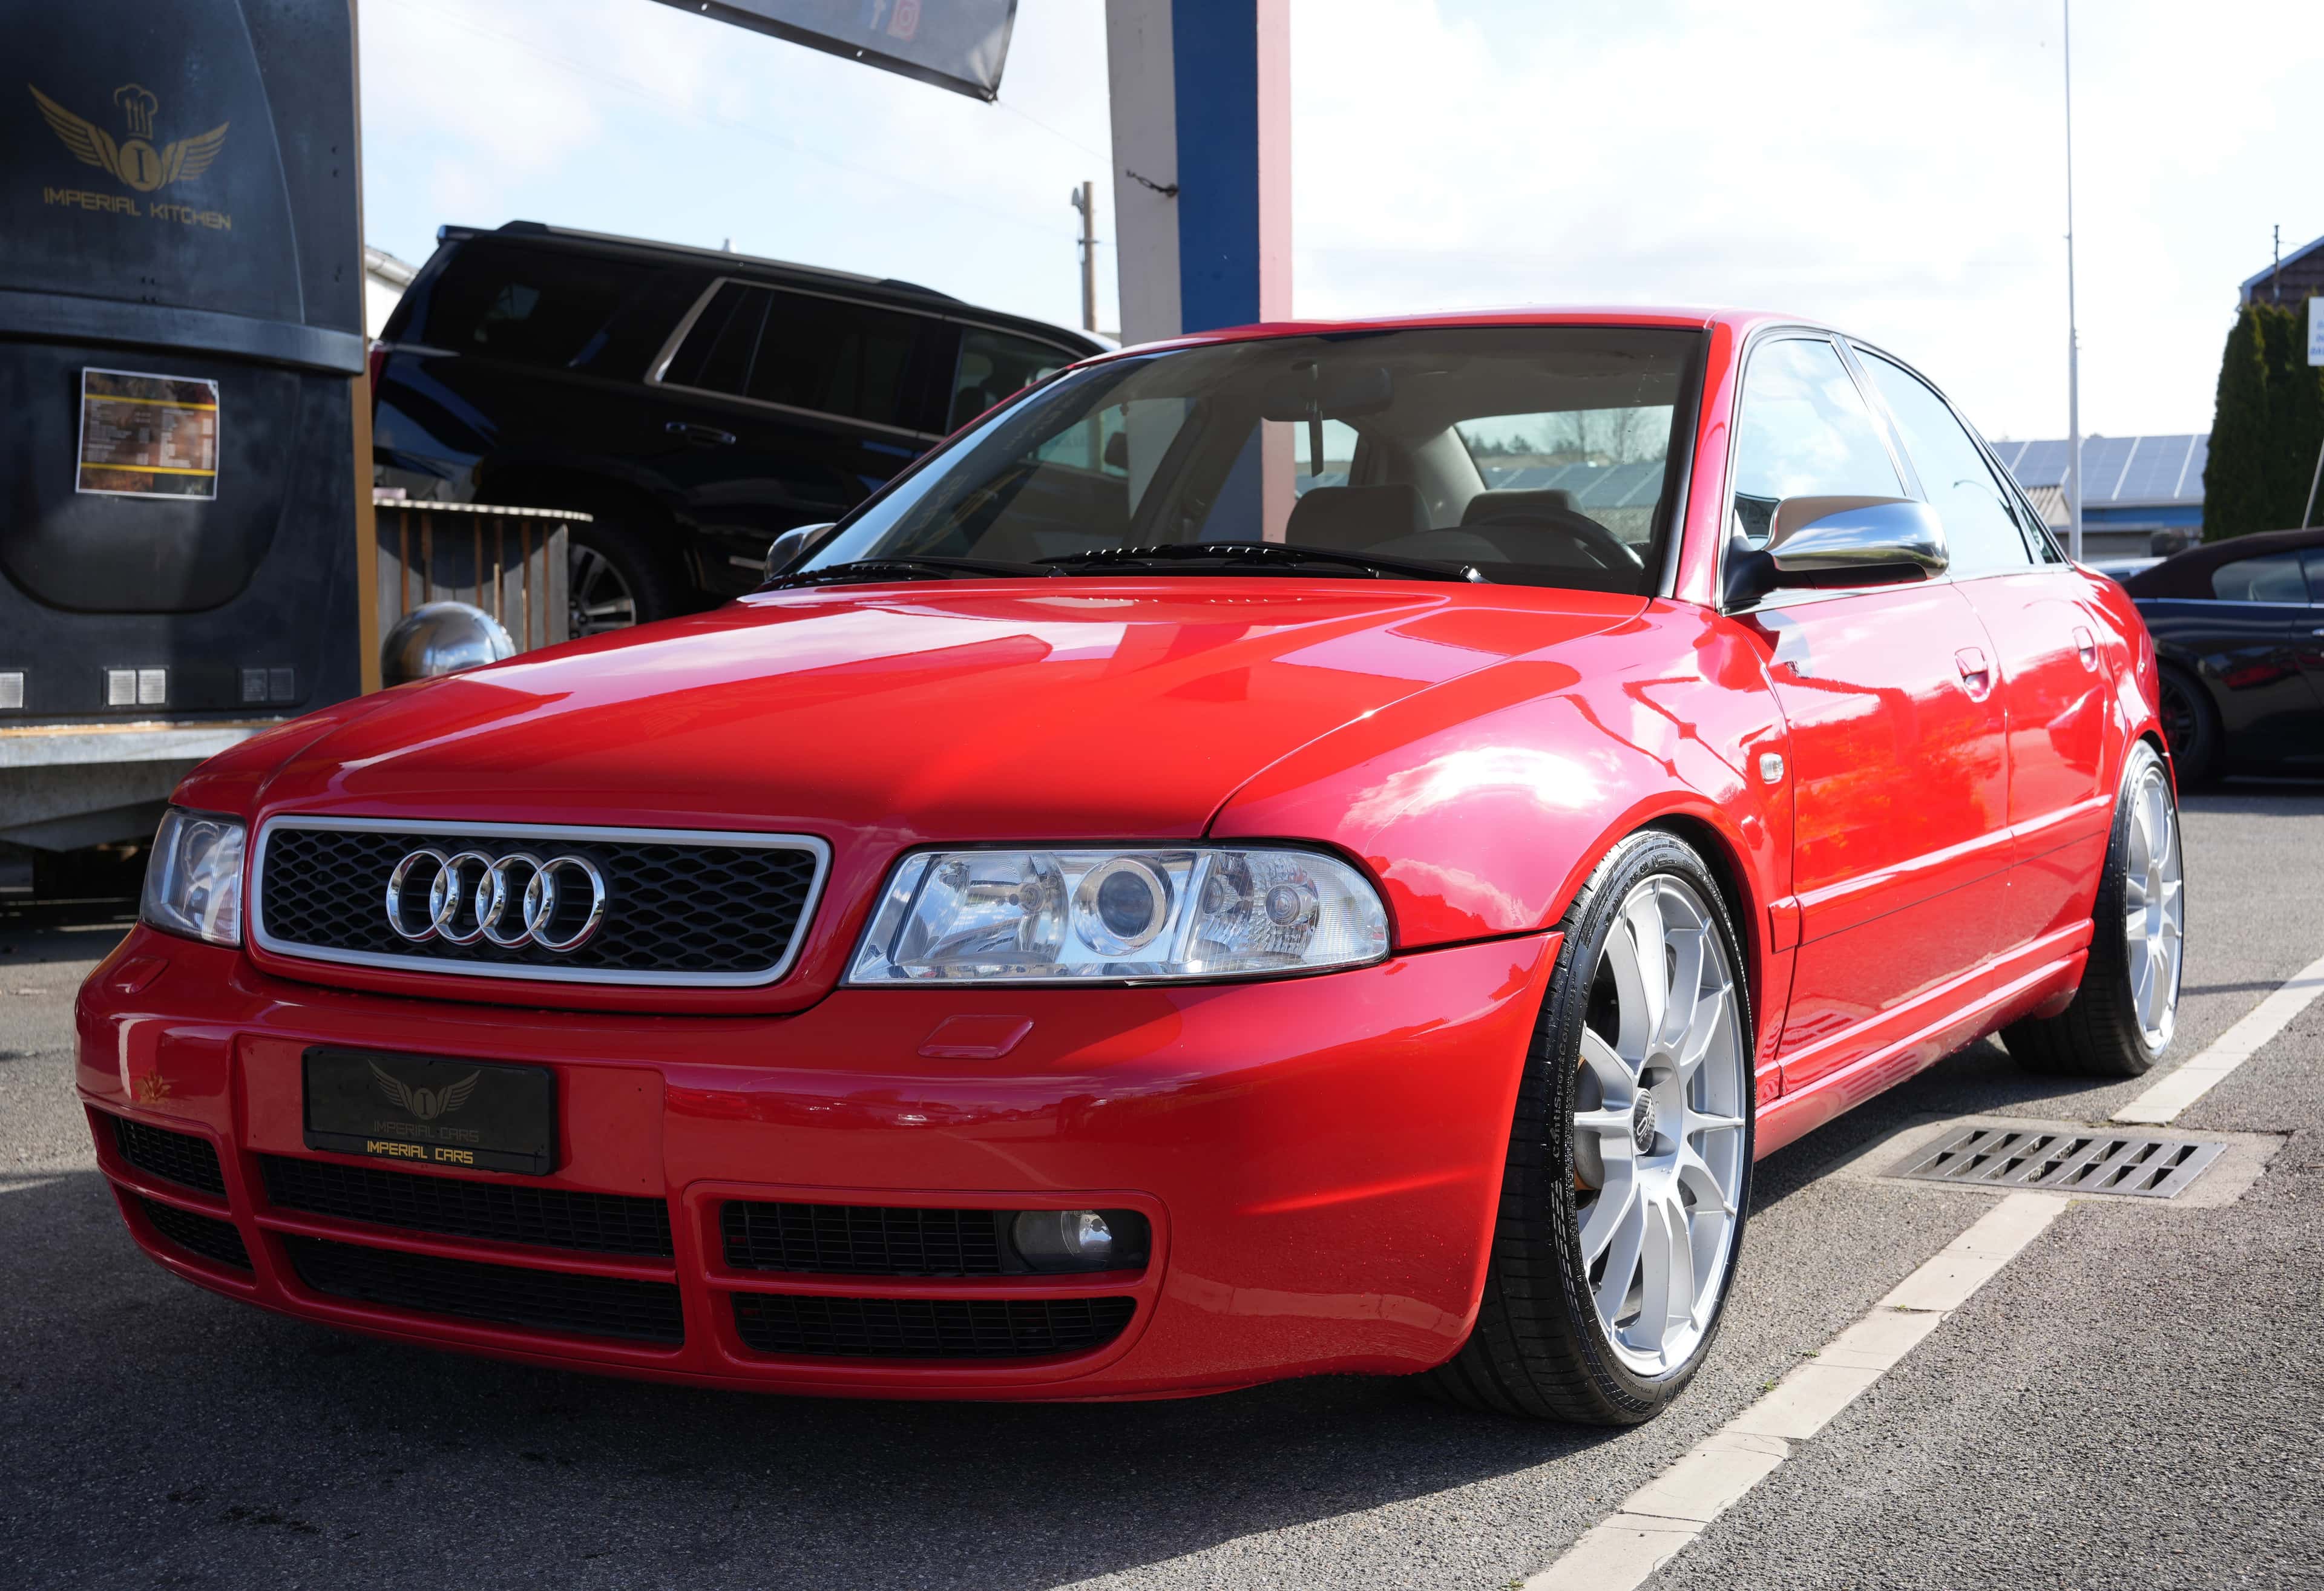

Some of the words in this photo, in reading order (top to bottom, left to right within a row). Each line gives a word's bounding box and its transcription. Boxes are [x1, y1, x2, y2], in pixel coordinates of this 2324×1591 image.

[44, 186, 141, 216] IMPERIAL
[150, 202, 232, 231] KITCHEN
[373, 1120, 435, 1139] IMPERIAL
[439, 1127, 480, 1143] CARS
[367, 1140, 428, 1160] IMPERIAL
[435, 1147, 474, 1165] CARS
